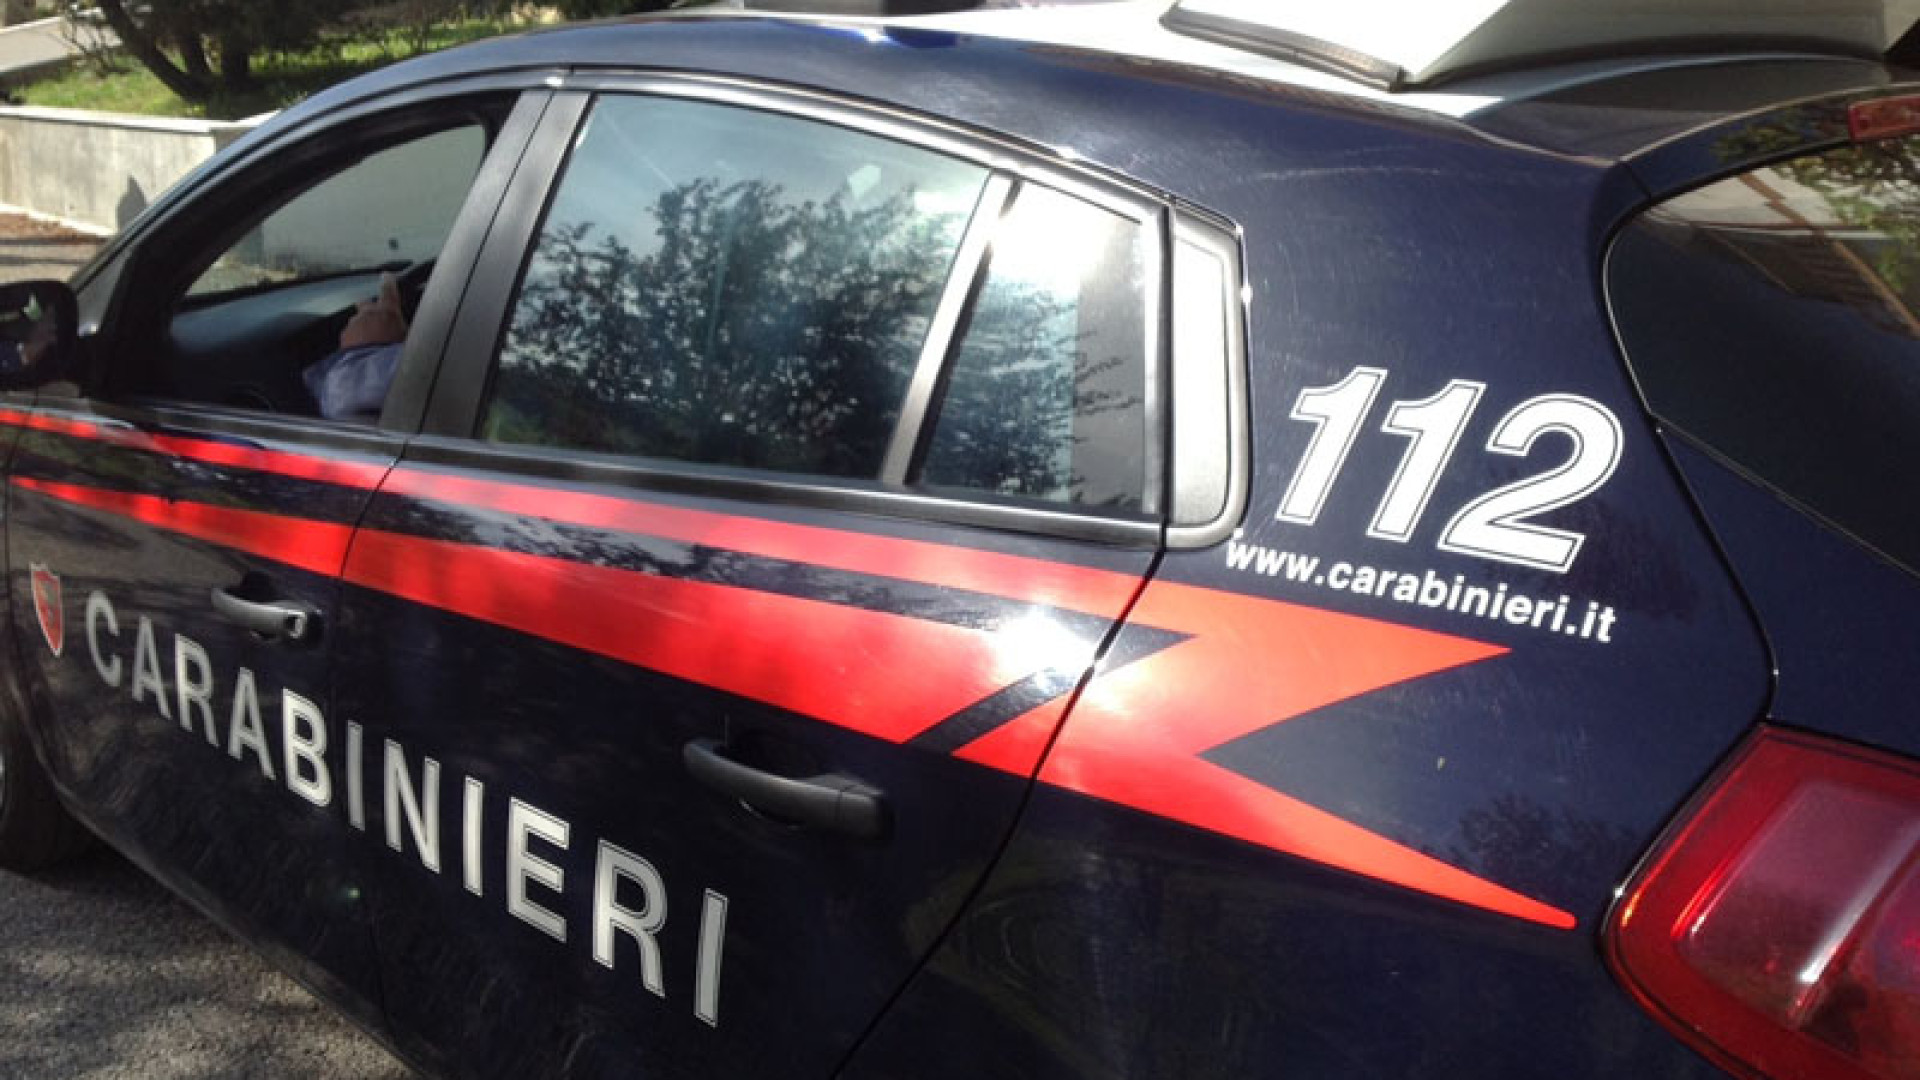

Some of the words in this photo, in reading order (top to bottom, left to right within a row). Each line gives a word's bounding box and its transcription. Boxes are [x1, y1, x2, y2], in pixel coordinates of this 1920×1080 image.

[1275, 365, 1625, 574] 112
[1225, 538, 1617, 643] www.carabinieri.it
[86, 591, 728, 1028] CARABINIERI
